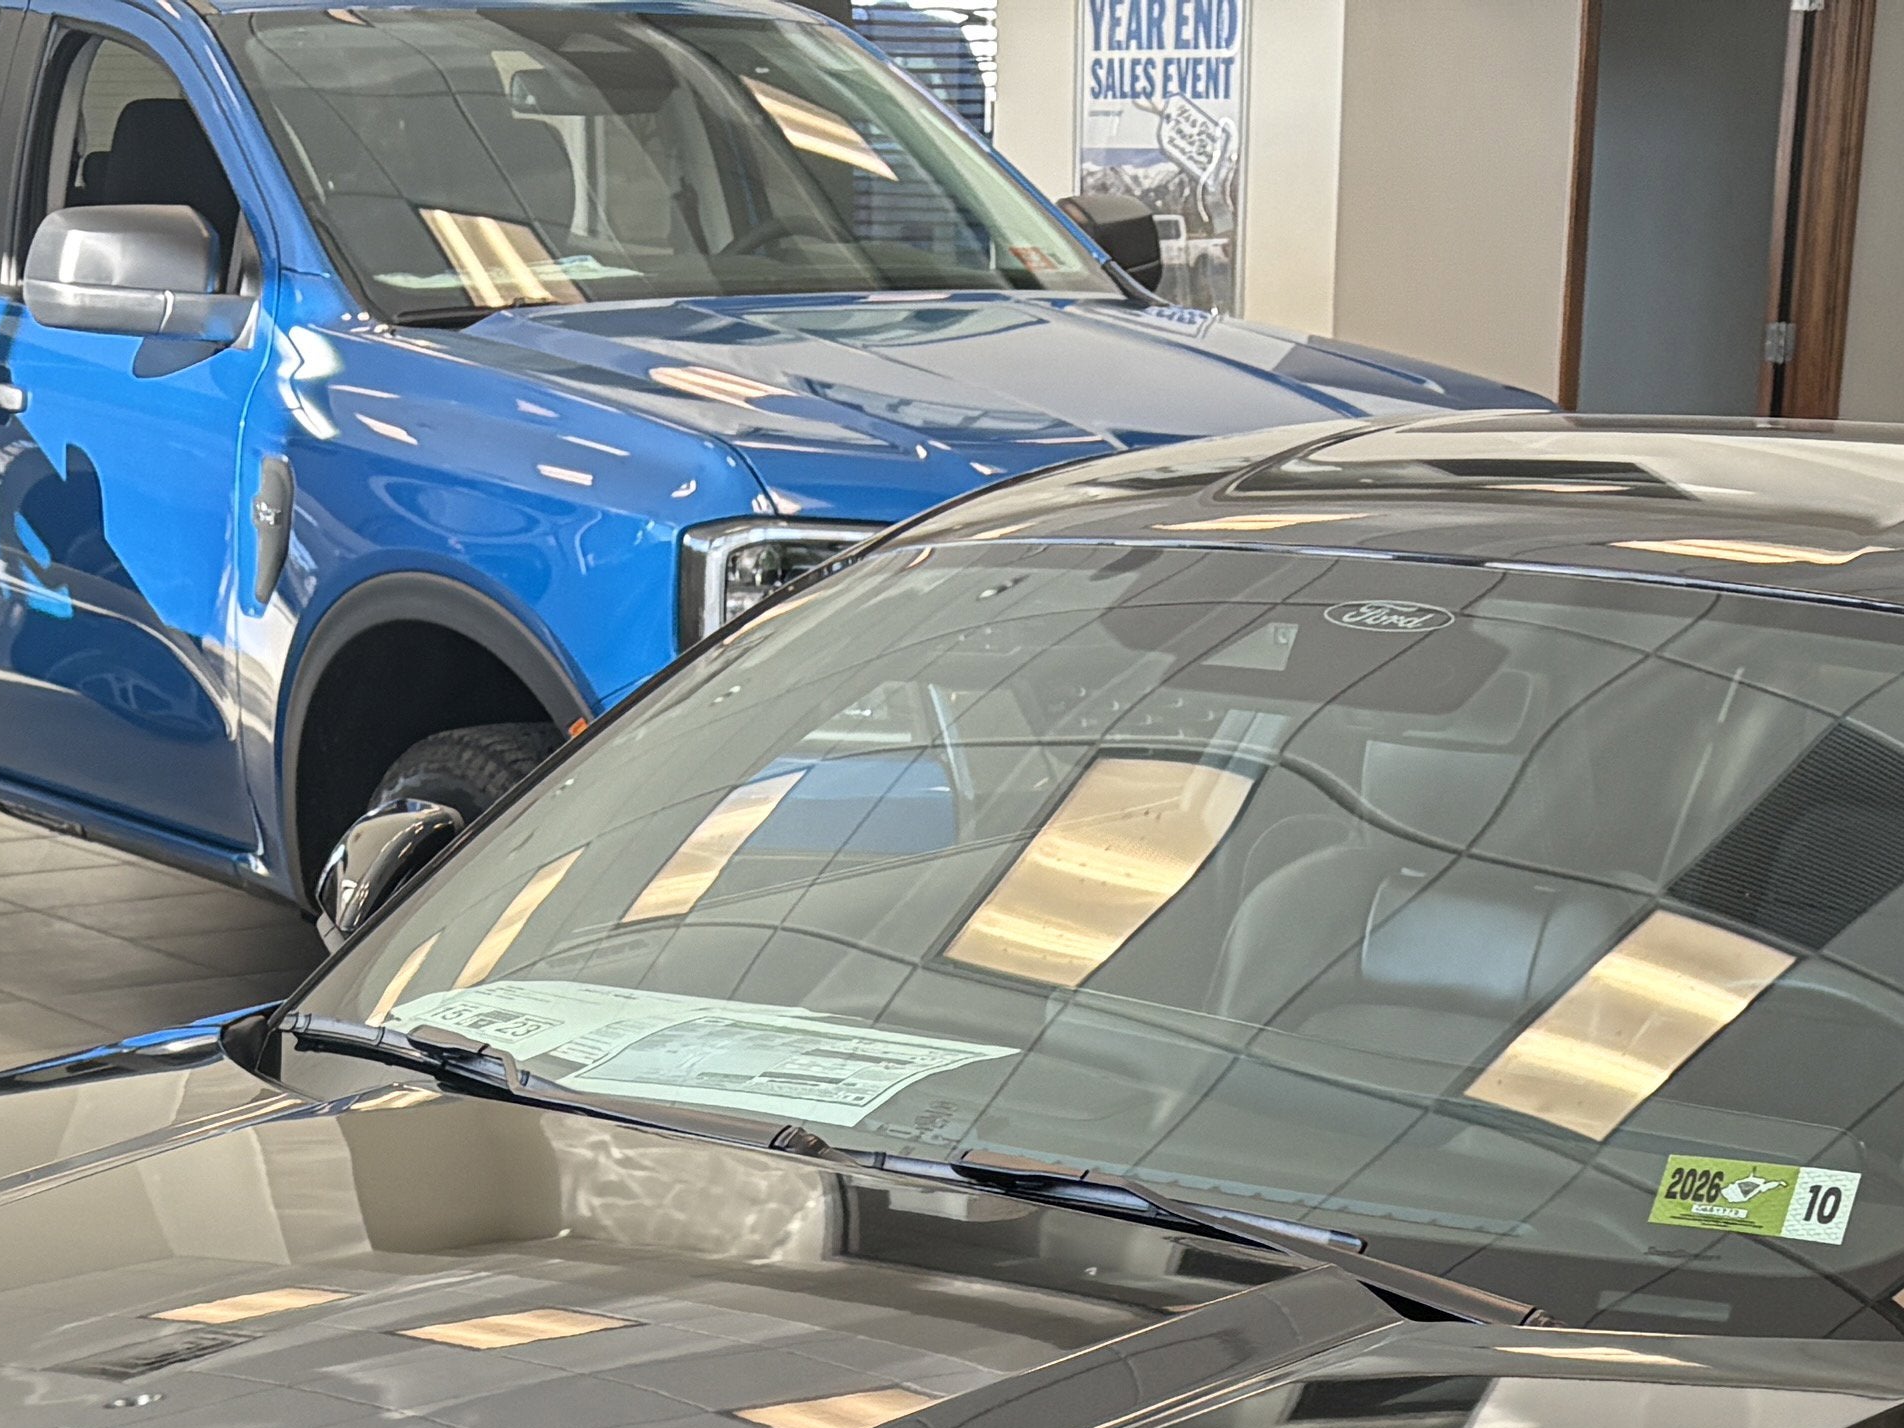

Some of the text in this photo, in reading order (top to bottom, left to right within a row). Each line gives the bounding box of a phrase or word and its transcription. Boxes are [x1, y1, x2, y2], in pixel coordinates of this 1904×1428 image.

[1090, 0, 1238, 51] YEAR END
[1091, 56, 1235, 100] SALES EVENT
[1342, 601, 1435, 629] Ford
[1664, 1166, 1725, 1203] 2026
[1803, 1184, 1843, 1225] 10
